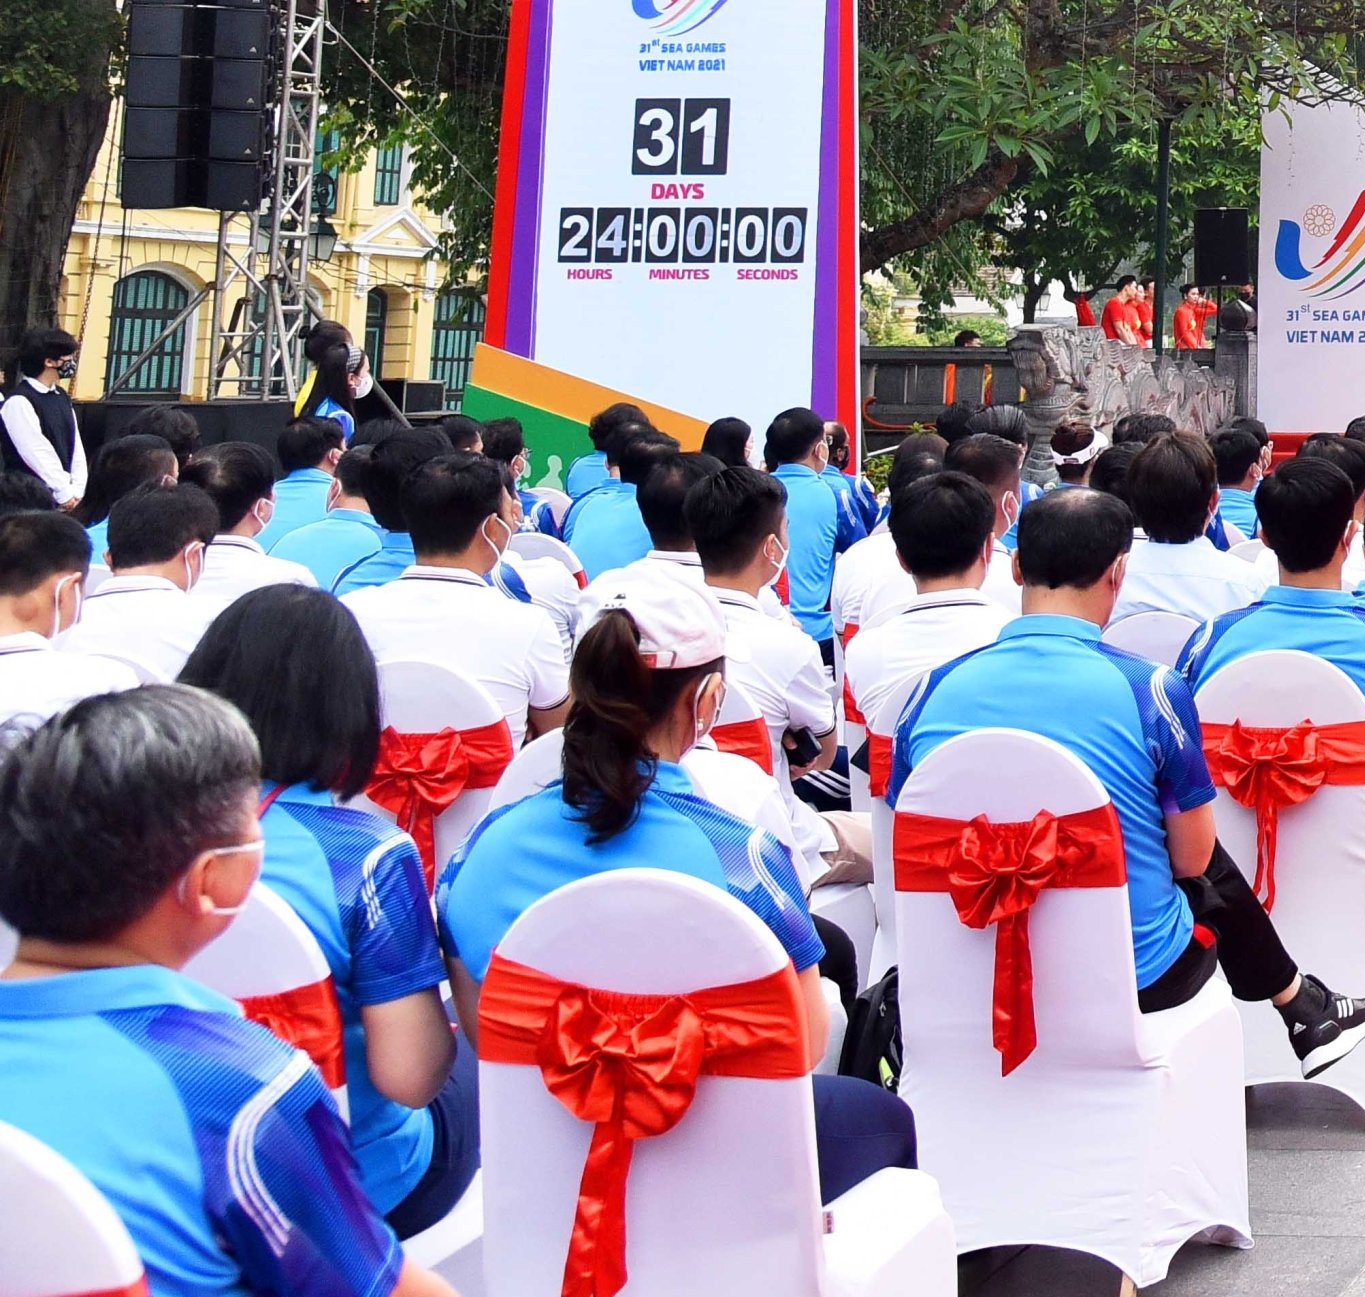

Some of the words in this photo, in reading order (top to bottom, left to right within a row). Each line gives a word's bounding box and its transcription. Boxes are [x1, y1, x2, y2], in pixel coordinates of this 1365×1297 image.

[661, 43, 683, 53] SEA
[686, 43, 726, 53] GAMES
[639, 59, 665, 72] VIET
[667, 59, 695, 72] NAM
[698, 58, 726, 72] 2021
[635, 106, 719, 167] 31
[650, 183, 705, 200] DAYS
[567, 268, 613, 281] HOURS
[649, 268, 710, 281] MINUTES
[736, 268, 799, 281] SECONDS
[1313, 310, 1339, 321] SEA
[1286, 330, 1317, 343] VIET
[1320, 330, 1354, 343] NAM
